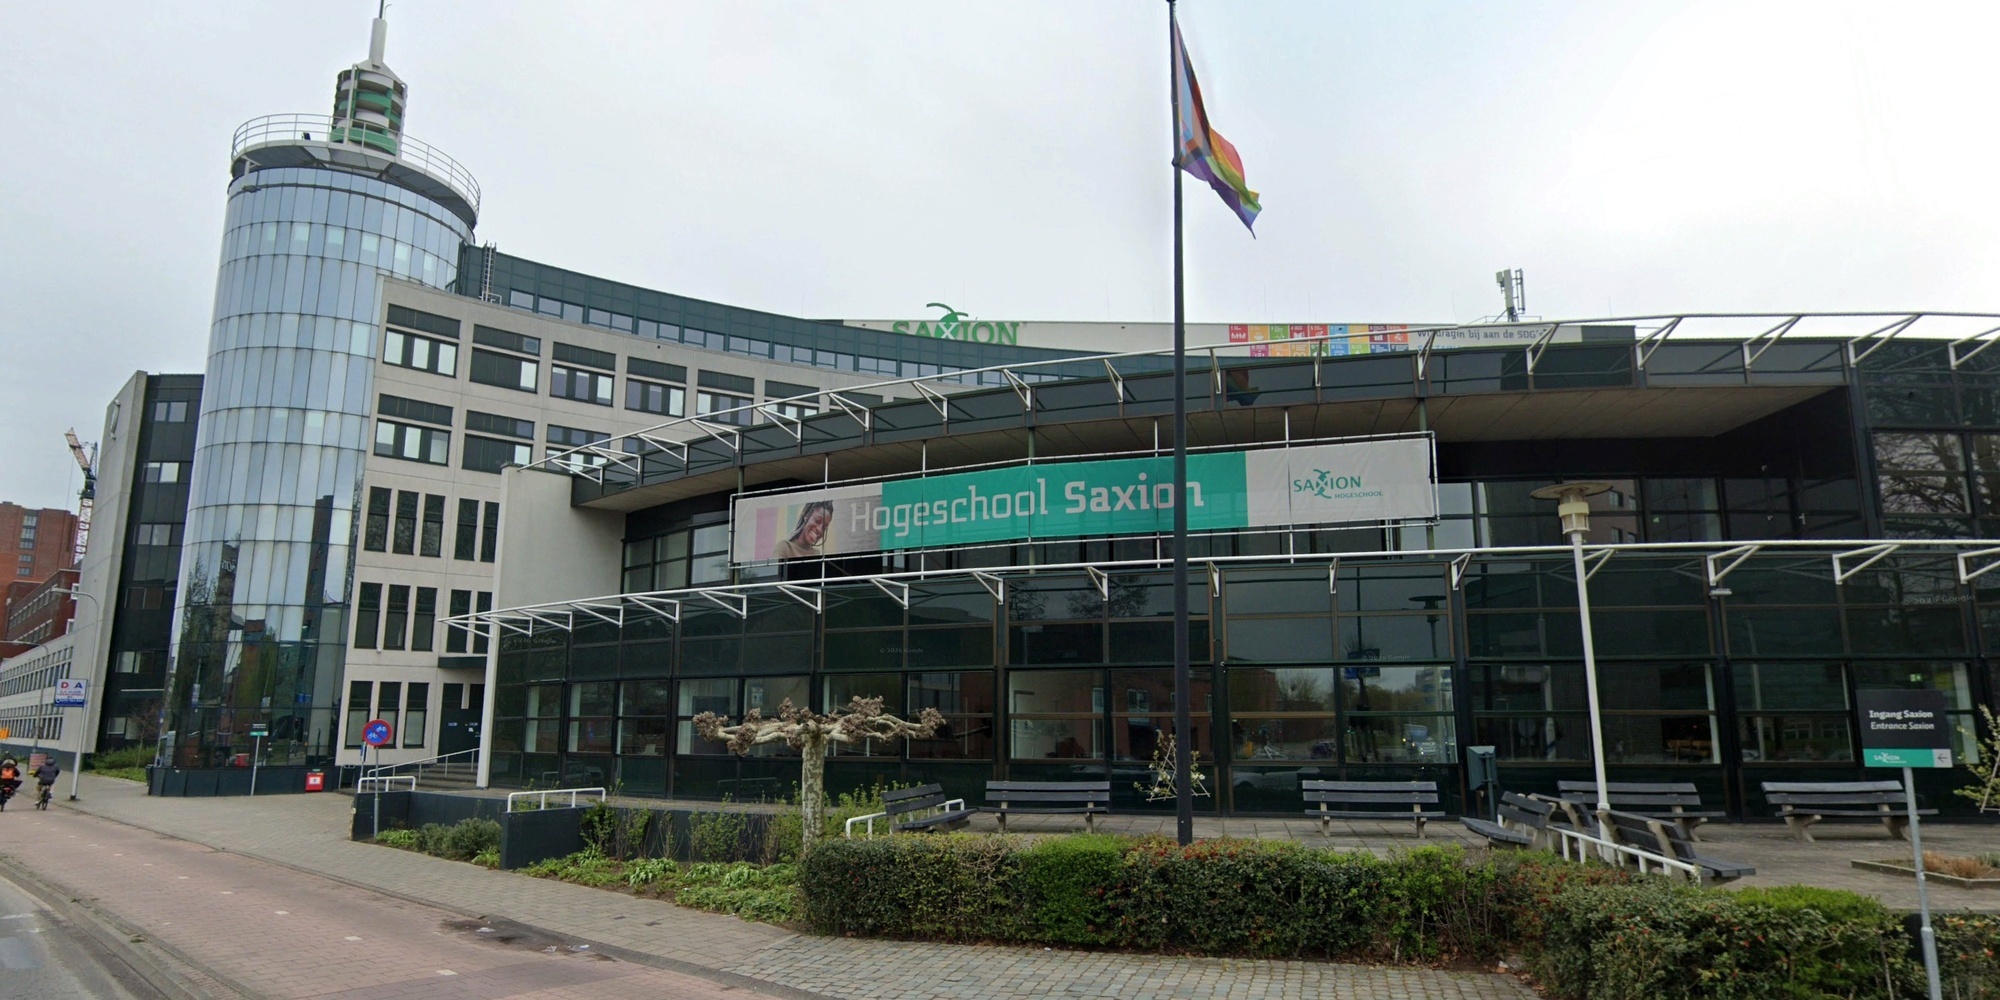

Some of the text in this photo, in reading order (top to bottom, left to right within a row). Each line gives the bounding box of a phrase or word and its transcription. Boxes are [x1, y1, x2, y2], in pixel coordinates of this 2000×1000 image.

[892, 315, 1019, 347] SAXION
[1468, 329, 1480, 340] bij
[1503, 328, 1514, 338] de
[1293, 471, 1361, 497] SAXION
[1334, 490, 1383, 499] HOGESCHOOL
[850, 472, 1205, 537] Hogeschool Saxion
[1868, 709, 1933, 720] Ingang Saxion
[1870, 721, 1935, 730] Entrance Saxion
